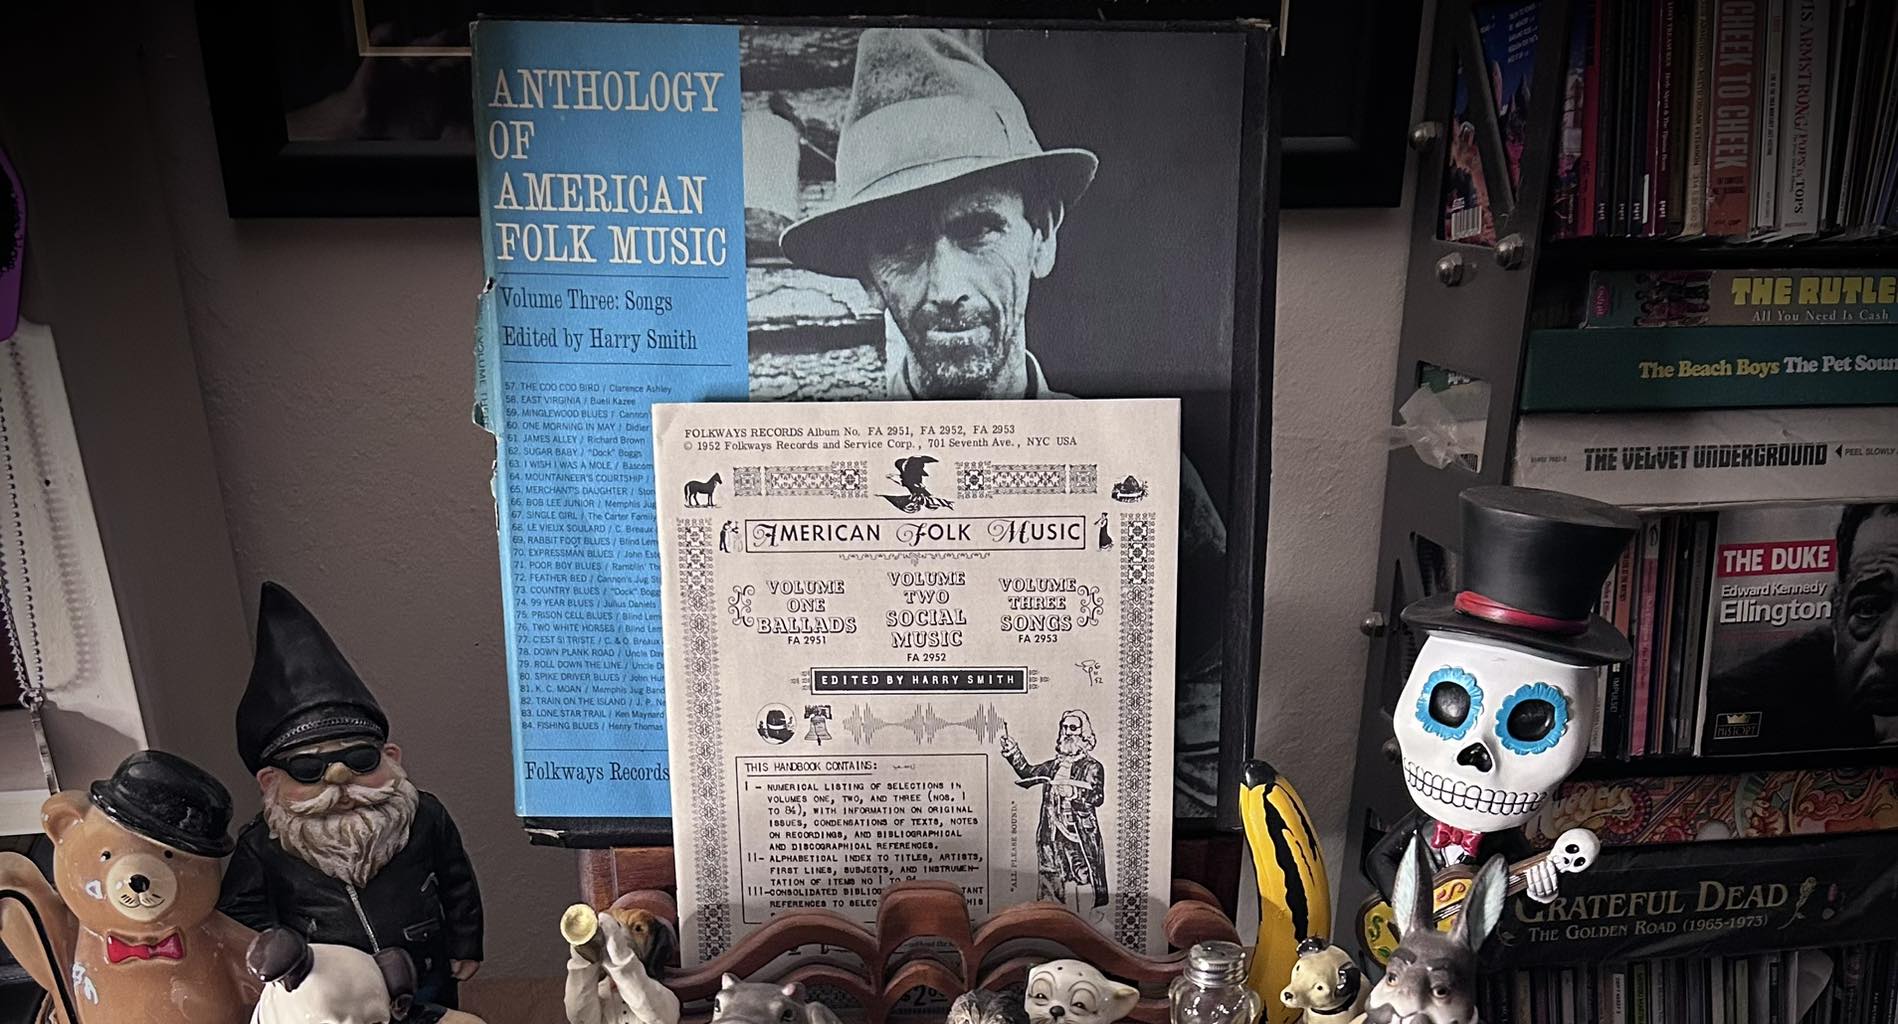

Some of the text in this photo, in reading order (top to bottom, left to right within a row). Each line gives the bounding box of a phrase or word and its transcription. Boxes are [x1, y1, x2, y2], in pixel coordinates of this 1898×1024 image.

[1719, 0, 1755, 66] CHEEK
[487, 69, 726, 113] ANTHOLOGY
[1719, 72, 1752, 101] TO
[488, 120, 535, 161] OF
[1714, 106, 1750, 169] CHEEK
[494, 171, 708, 216] AMERICAN
[1794, 181, 1806, 214] TOPS
[495, 222, 727, 267] FOLK MUSIC
[1731, 277, 1793, 305] THE
[501, 287, 674, 316] Volume Three: Songs
[1752, 309, 1889, 322] All You Need Is Cash
[502, 326, 698, 355] Edited by Harry Smith
[1639, 362, 1673, 378] The
[1679, 360, 1732, 377] Beach
[1737, 358, 1780, 378] Boys
[1784, 356, 1818, 374] The
[1821, 355, 1852, 373] Pet
[521, 383, 537, 392] THE
[579, 384, 599, 392] BIRD
[523, 435, 645, 445] JAMES ALLEY Richard Brown
[685, 425, 1016, 438] FOLKWAYS RECORDS Album No. FA 2951, FA 2952, FA 2953
[697, 441, 721, 450] 1952
[725, 440, 772, 452] Folkways
[776, 440, 819, 450] Records
[823, 440, 840, 449] and
[844, 439, 883, 449] Service
[928, 439, 945, 448] 701
[949, 438, 988, 448] Seventh
[1027, 437, 1051, 447] NYC
[1056, 437, 1077, 446] USA
[1584, 447, 1618, 472] THE
[1622, 446, 1691, 471] VELVET
[1693, 443, 1828, 469] UNDERGROUND
[753, 519, 1081, 548] AMERICAN FOLK MUSIC
[1723, 545, 1831, 573] THE DUKE
[766, 579, 845, 595] VOLUME
[887, 571, 966, 587] VOLUME
[999, 577, 1077, 593] VOLUME
[904, 589, 950, 604] TWO
[1721, 581, 1827, 599] Edward Kennedy
[787, 598, 826, 613] ONE
[1008, 596, 1066, 610] THREE
[886, 609, 967, 627] SOCIAL
[1719, 600, 1833, 627] Ellington
[757, 617, 858, 635] BALLADS
[1000, 614, 1073, 632] SONGS
[788, 636, 827, 645] FA 2951
[891, 630, 963, 648] MUSIC
[1019, 634, 1058, 643] FA 2953
[907, 653, 947, 662] FA 2952
[821, 675, 1015, 685] EDITED BY HARRY SMITH
[536, 710, 558, 718] LONE
[560, 710, 582, 718] STAR
[584, 710, 607, 718] TRAIL
[537, 722, 663, 732] FISHING BLUES Henry Thomas
[524, 761, 670, 785] Folkways Records
[745, 761, 877, 772] THIS HANDBOOK CONTAINS:
[767, 783, 818, 791] NUMERICAL
[824, 783, 864, 791] LISTING
[887, 782, 944, 790] SELECTIONS
[951, 782, 962, 790] IN
[769, 817, 979, 829] ISSUES, CONDENSATIONS OF TEXTS, NOTES
[769, 831, 780, 839] ON
[785, 831, 847, 840] RECORDINGS,
[877, 830, 962, 838] BIBLIOGRAPHICAL
[791, 842, 872, 850] DISCOGRAPHICAL
[877, 842, 938, 850] REFERENCES.
[844, 854, 872, 862] INDEX
[894, 854, 932, 863] TITLES,
[940, 853, 983, 862] ARTISTS,
[804, 867, 837, 876] LINES,
[844, 866, 893, 875] SUBJECTS,
[1696, 880, 1791, 912] DEAD
[1529, 914, 1769, 943] THE GOLDEN ROAD (1965-1973)
